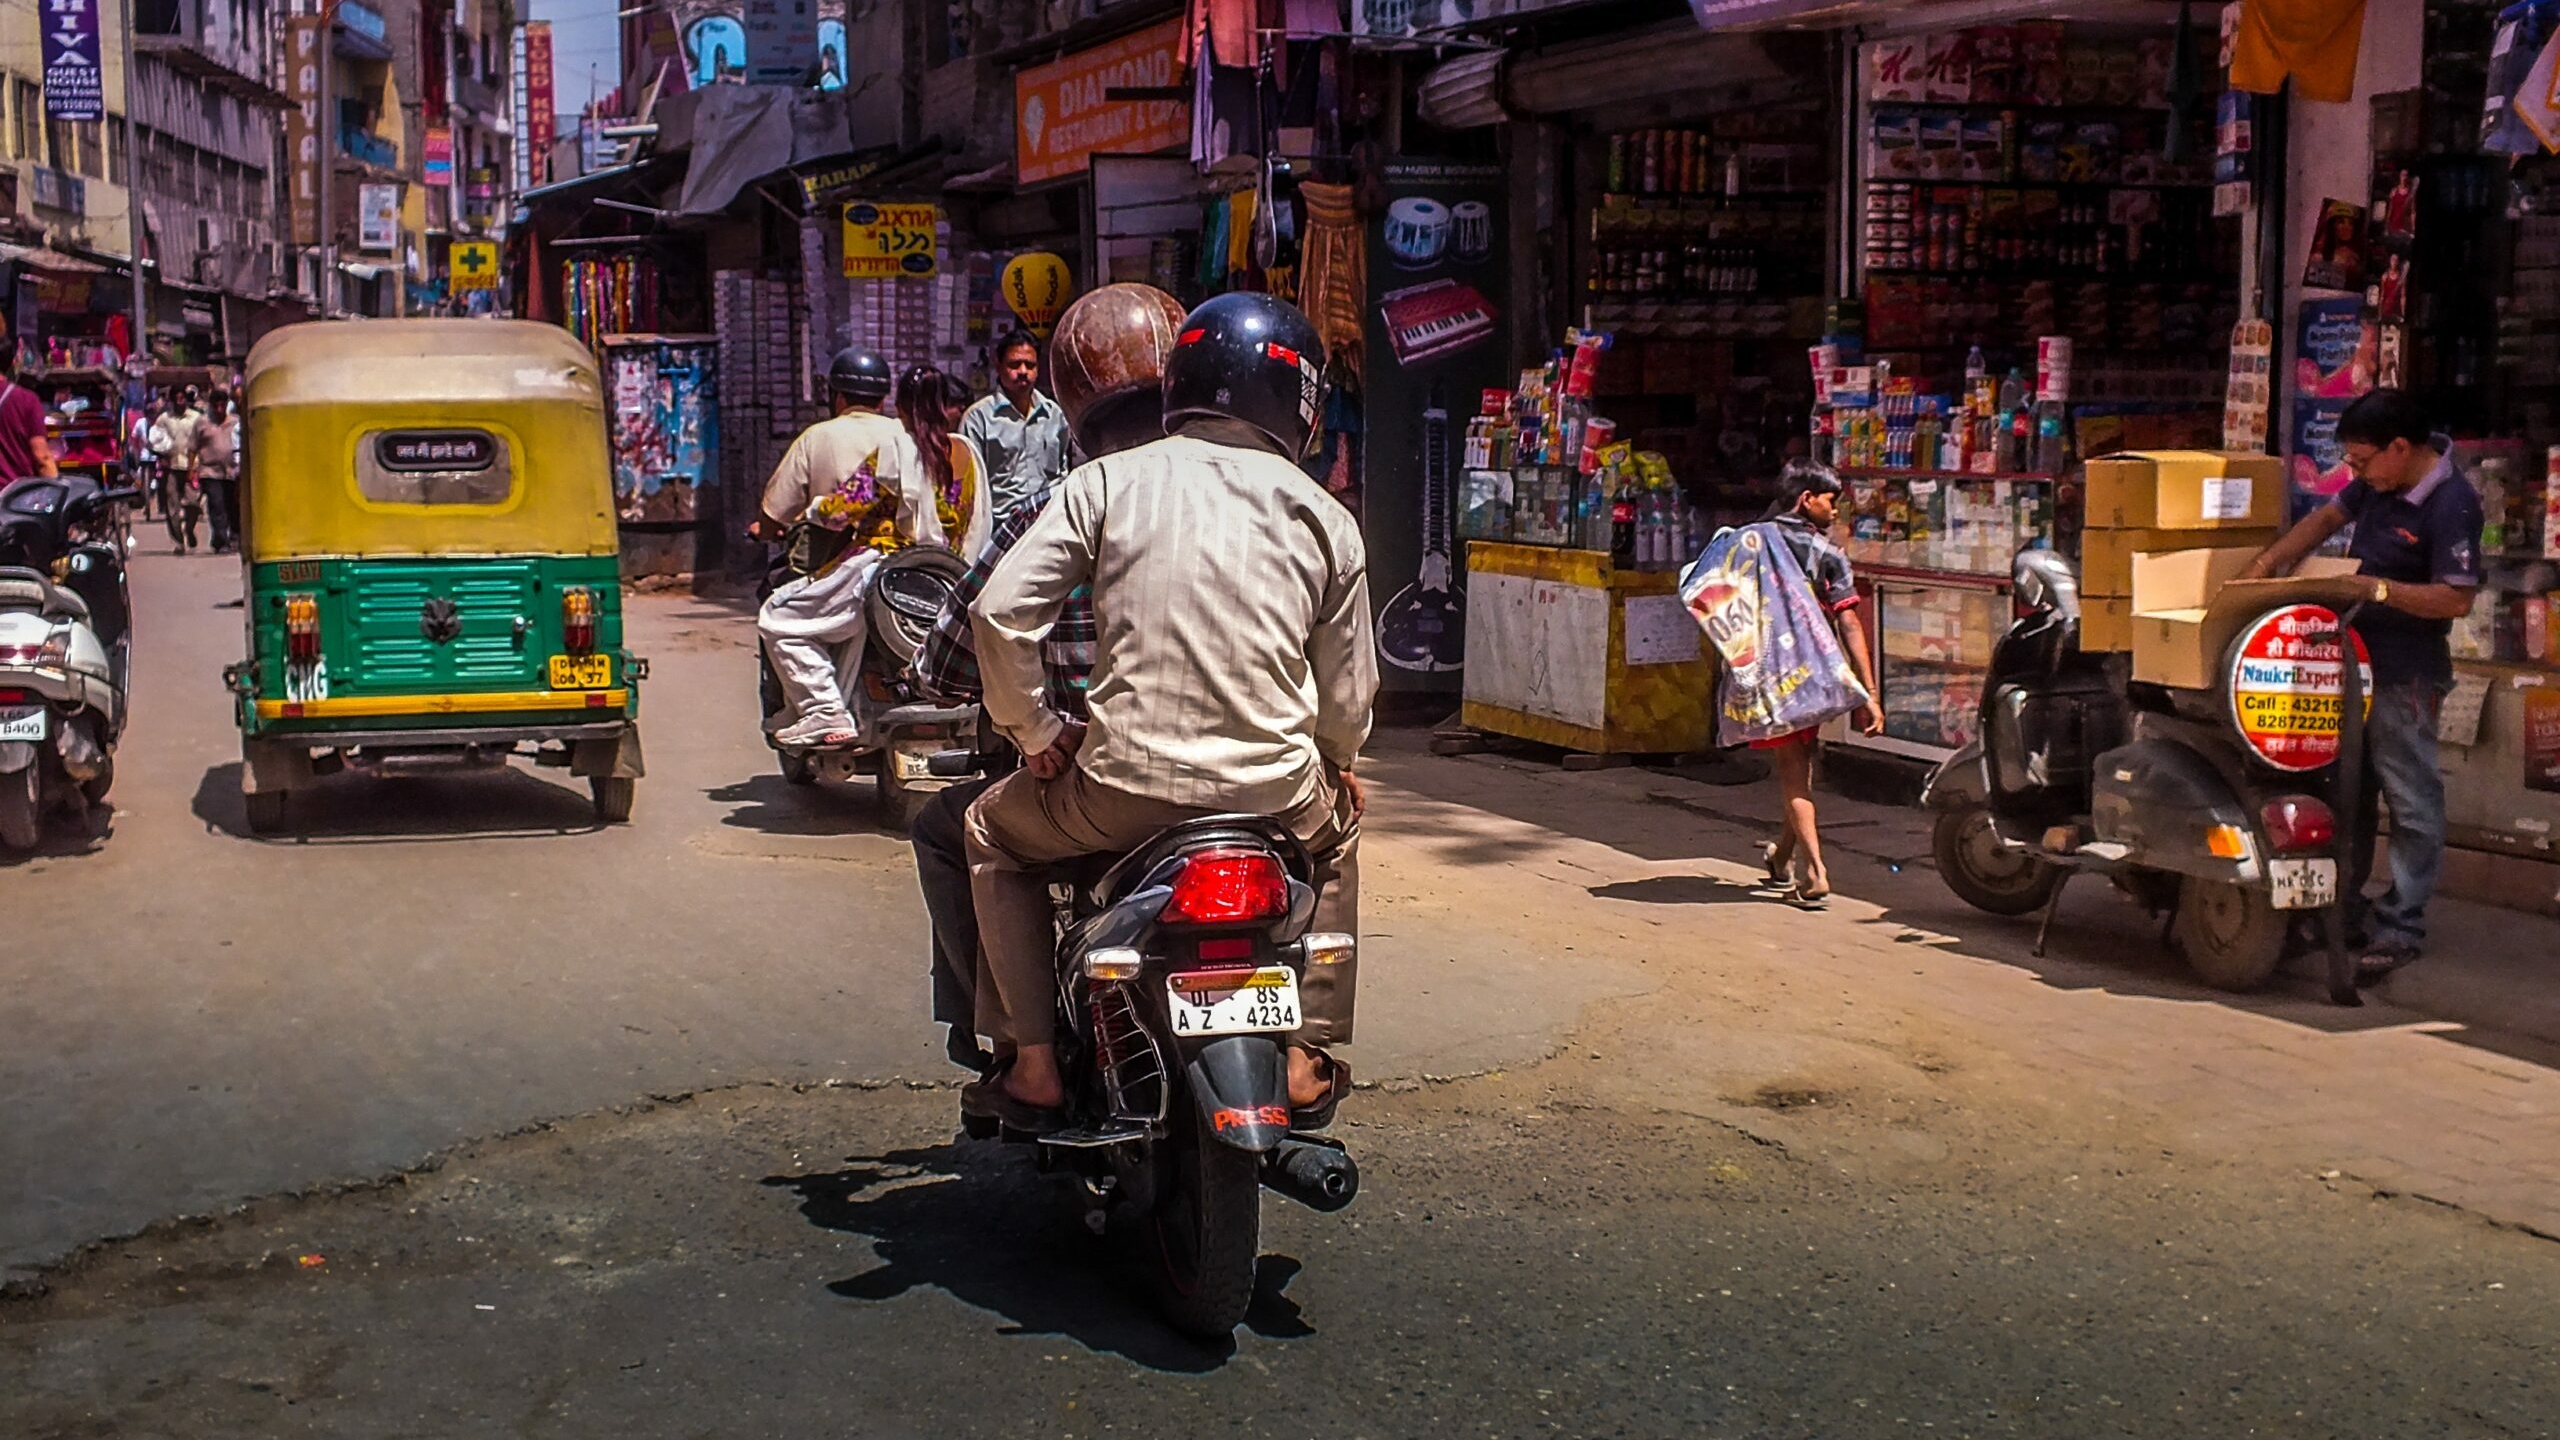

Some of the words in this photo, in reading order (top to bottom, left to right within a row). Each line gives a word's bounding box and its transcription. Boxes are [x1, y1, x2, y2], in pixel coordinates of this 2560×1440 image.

[46, 77, 99, 87] HOUSE
[47, 67, 98, 77] GUEST
[1060, 49, 1171, 118] DIAMOND
[297, 28, 317, 200] PAYAL
[1049, 106, 1132, 154] RESTAURANT
[1013, 265, 1028, 309] Kodak
[1045, 264, 1059, 307] Kodak
[2244, 697, 2277, 710] Call
[1247, 1005, 1295, 1027] 4234
[1213, 1104, 1290, 1132] PRESS
